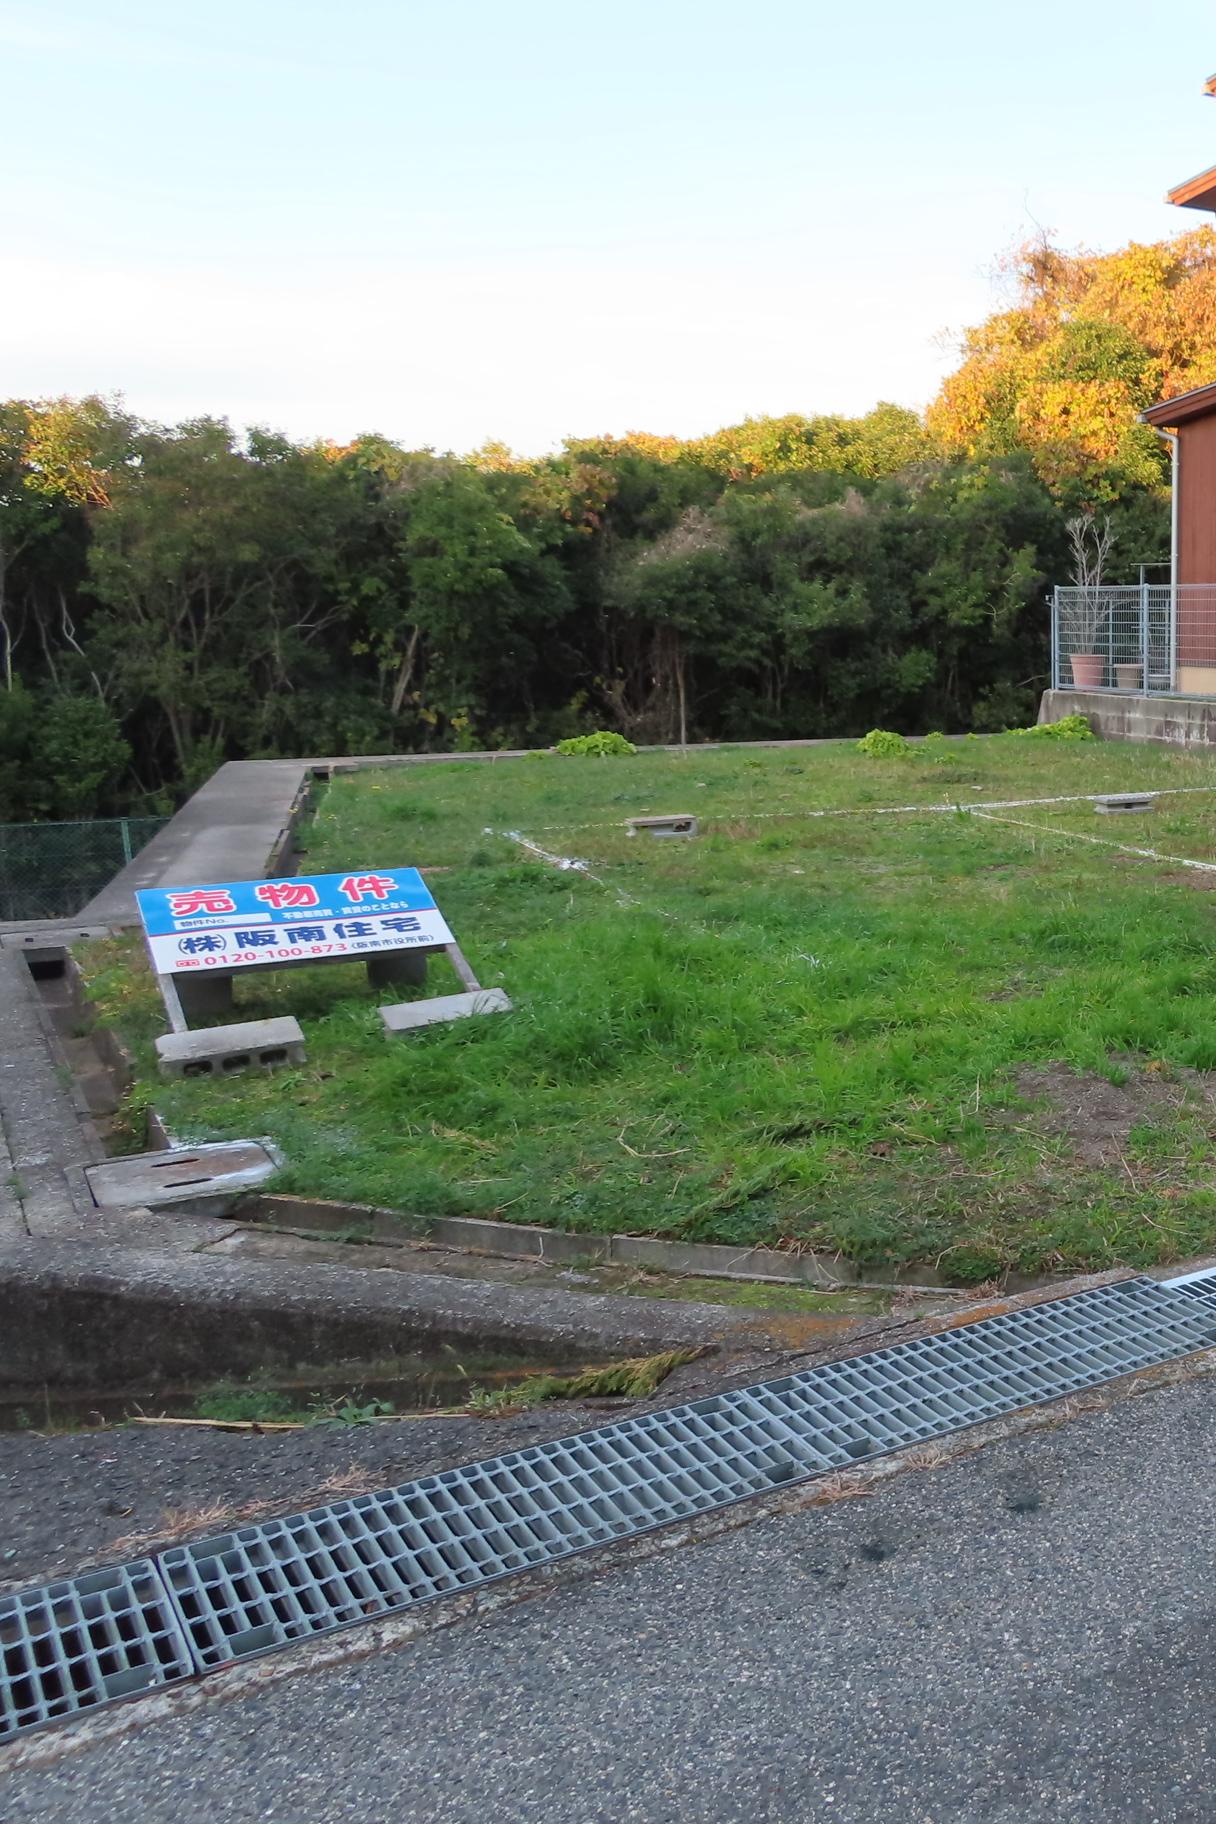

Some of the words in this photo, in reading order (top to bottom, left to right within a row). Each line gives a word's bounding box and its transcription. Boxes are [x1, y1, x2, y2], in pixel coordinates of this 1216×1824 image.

[168, 875, 398, 916] 売物件
[178, 916, 421, 954] (株)阪南住宅
[180, 918, 229, 928] 物件No.
[204, 944, 347, 966] 0120-100-873
